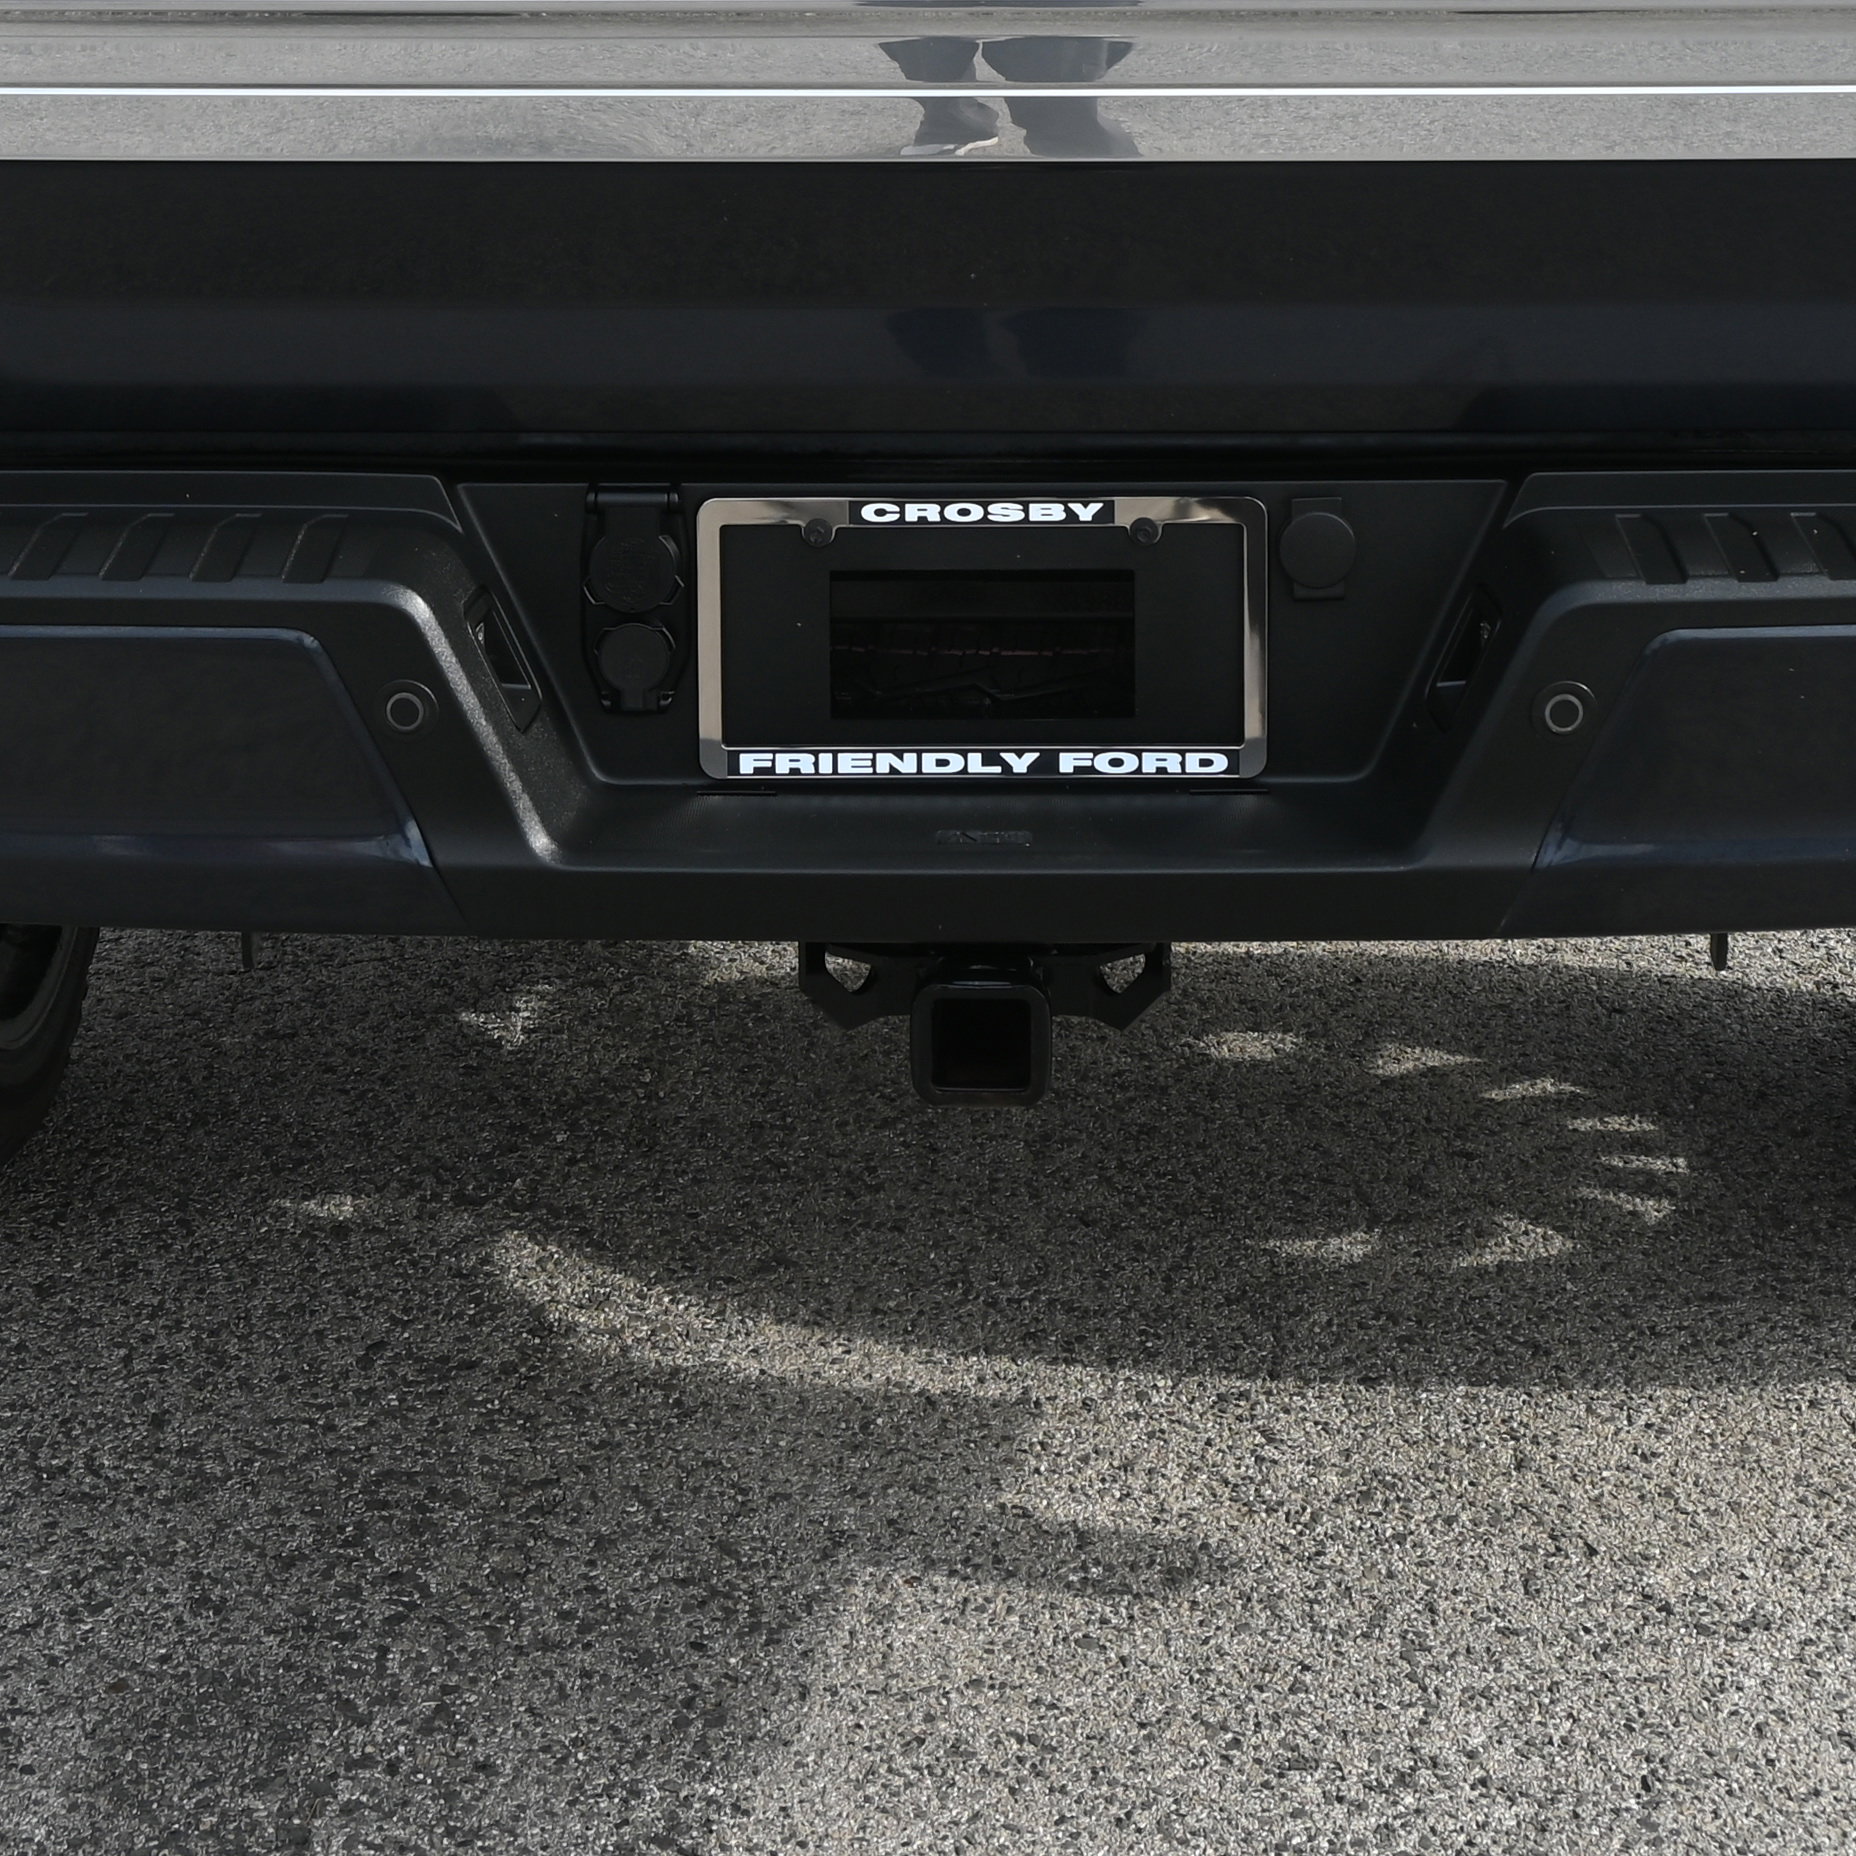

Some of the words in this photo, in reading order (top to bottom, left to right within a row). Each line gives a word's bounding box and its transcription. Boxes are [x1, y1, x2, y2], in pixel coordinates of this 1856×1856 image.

[859, 502, 1106, 524] CROSBY
[738, 752, 1041, 775] FRIENDLY
[1058, 752, 1229, 775] FORD
